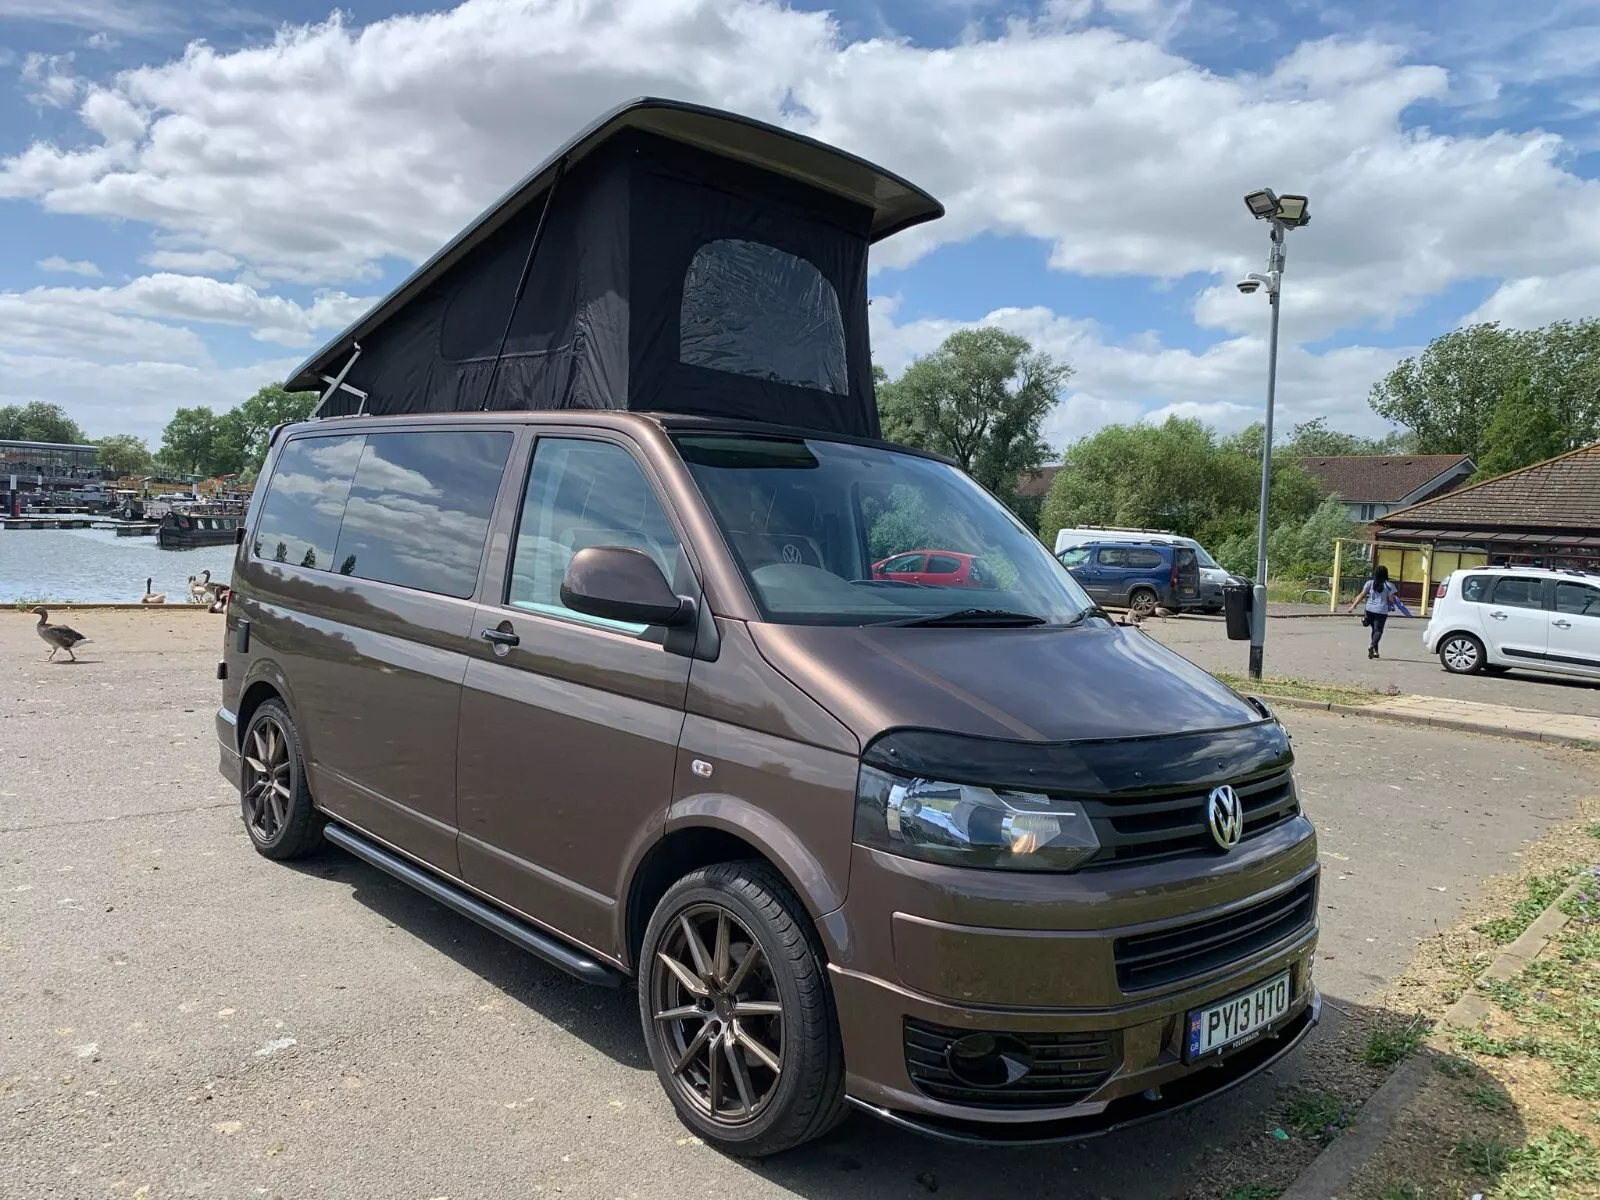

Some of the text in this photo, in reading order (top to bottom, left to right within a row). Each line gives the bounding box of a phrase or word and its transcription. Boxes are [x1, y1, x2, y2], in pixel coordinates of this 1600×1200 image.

[1208, 981, 1286, 1046] PY13 HTO
[1191, 1042, 1199, 1052] GB
